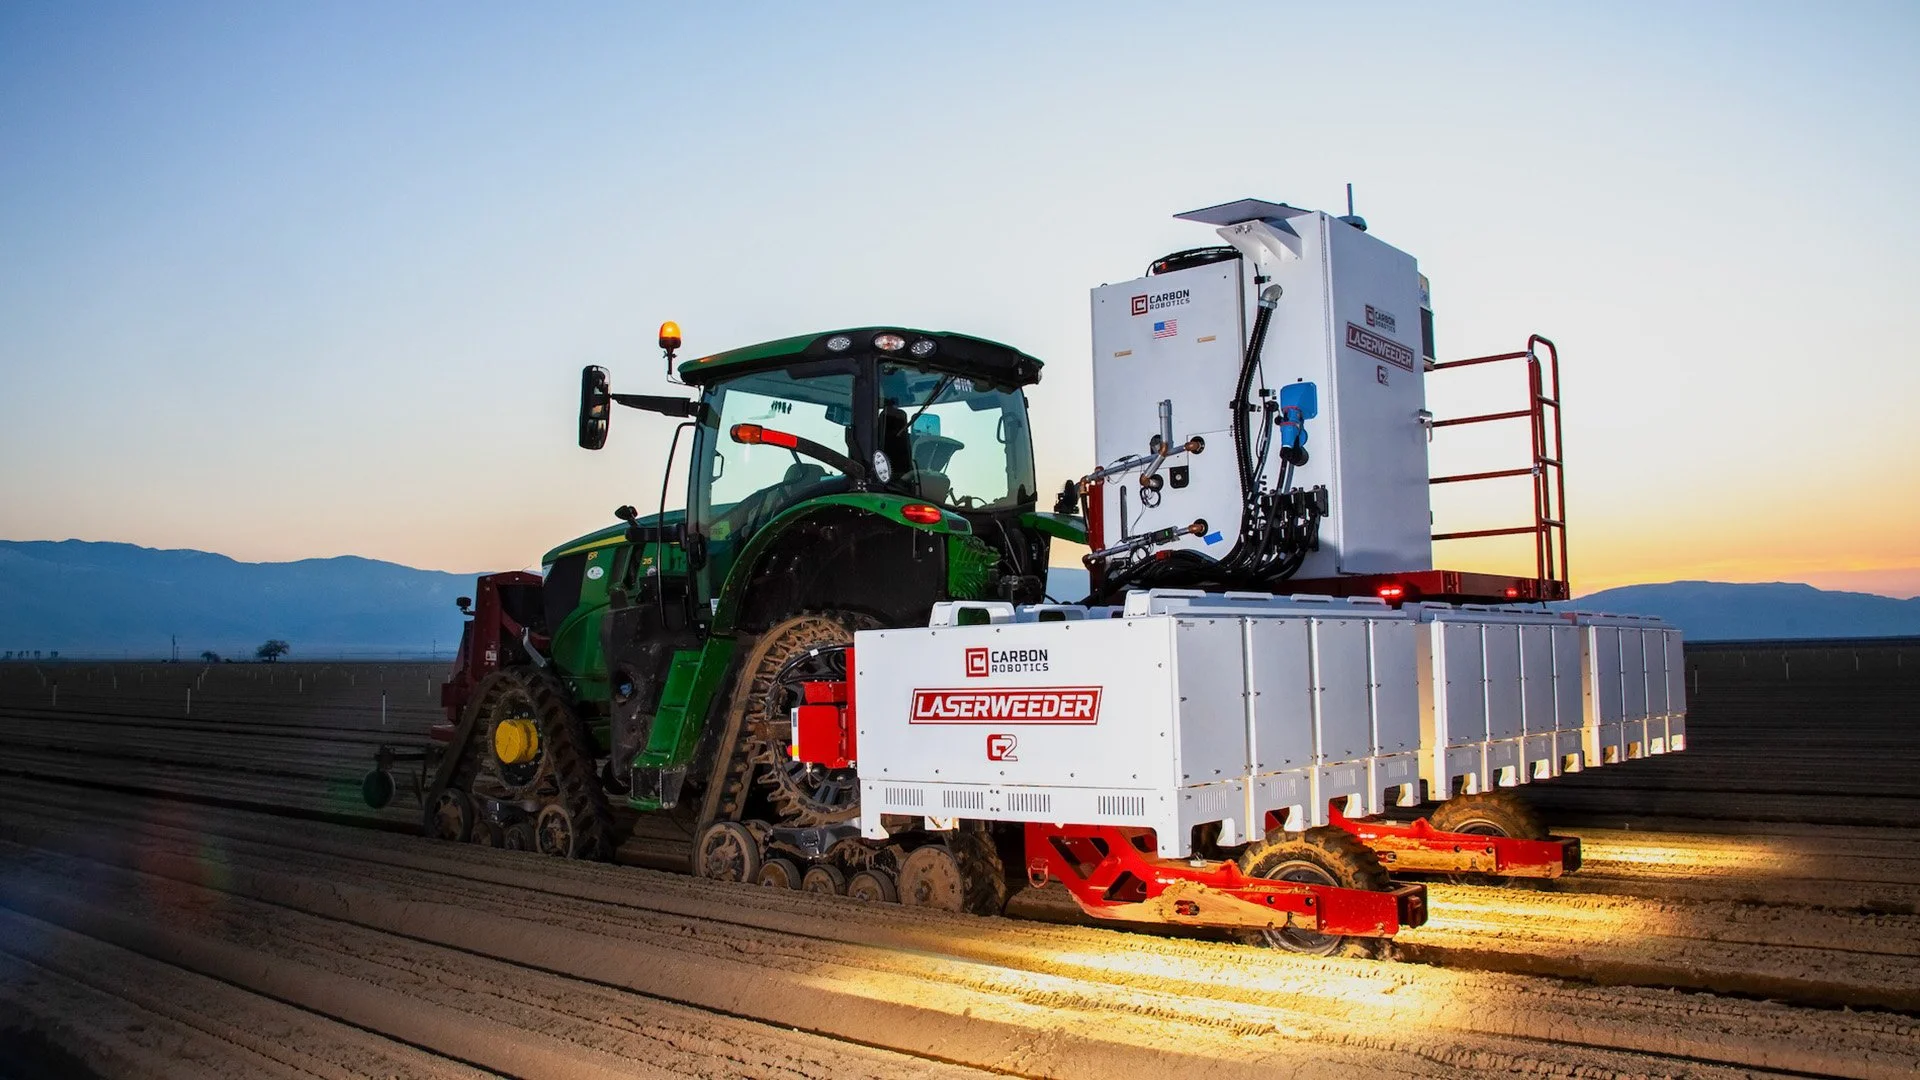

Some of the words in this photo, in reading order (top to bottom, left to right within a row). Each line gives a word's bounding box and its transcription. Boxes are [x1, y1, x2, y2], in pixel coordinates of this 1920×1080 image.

[1149, 289, 1190, 304] CARBON
[1149, 298, 1191, 310] ROBOTICS
[1349, 327, 1412, 367] LASERWEEDER
[991, 649, 1048, 663] CARBON
[991, 662, 1049, 673] ROBOTICS
[916, 694, 1093, 717] LASERWEEDER
[987, 734, 1018, 762] G2
